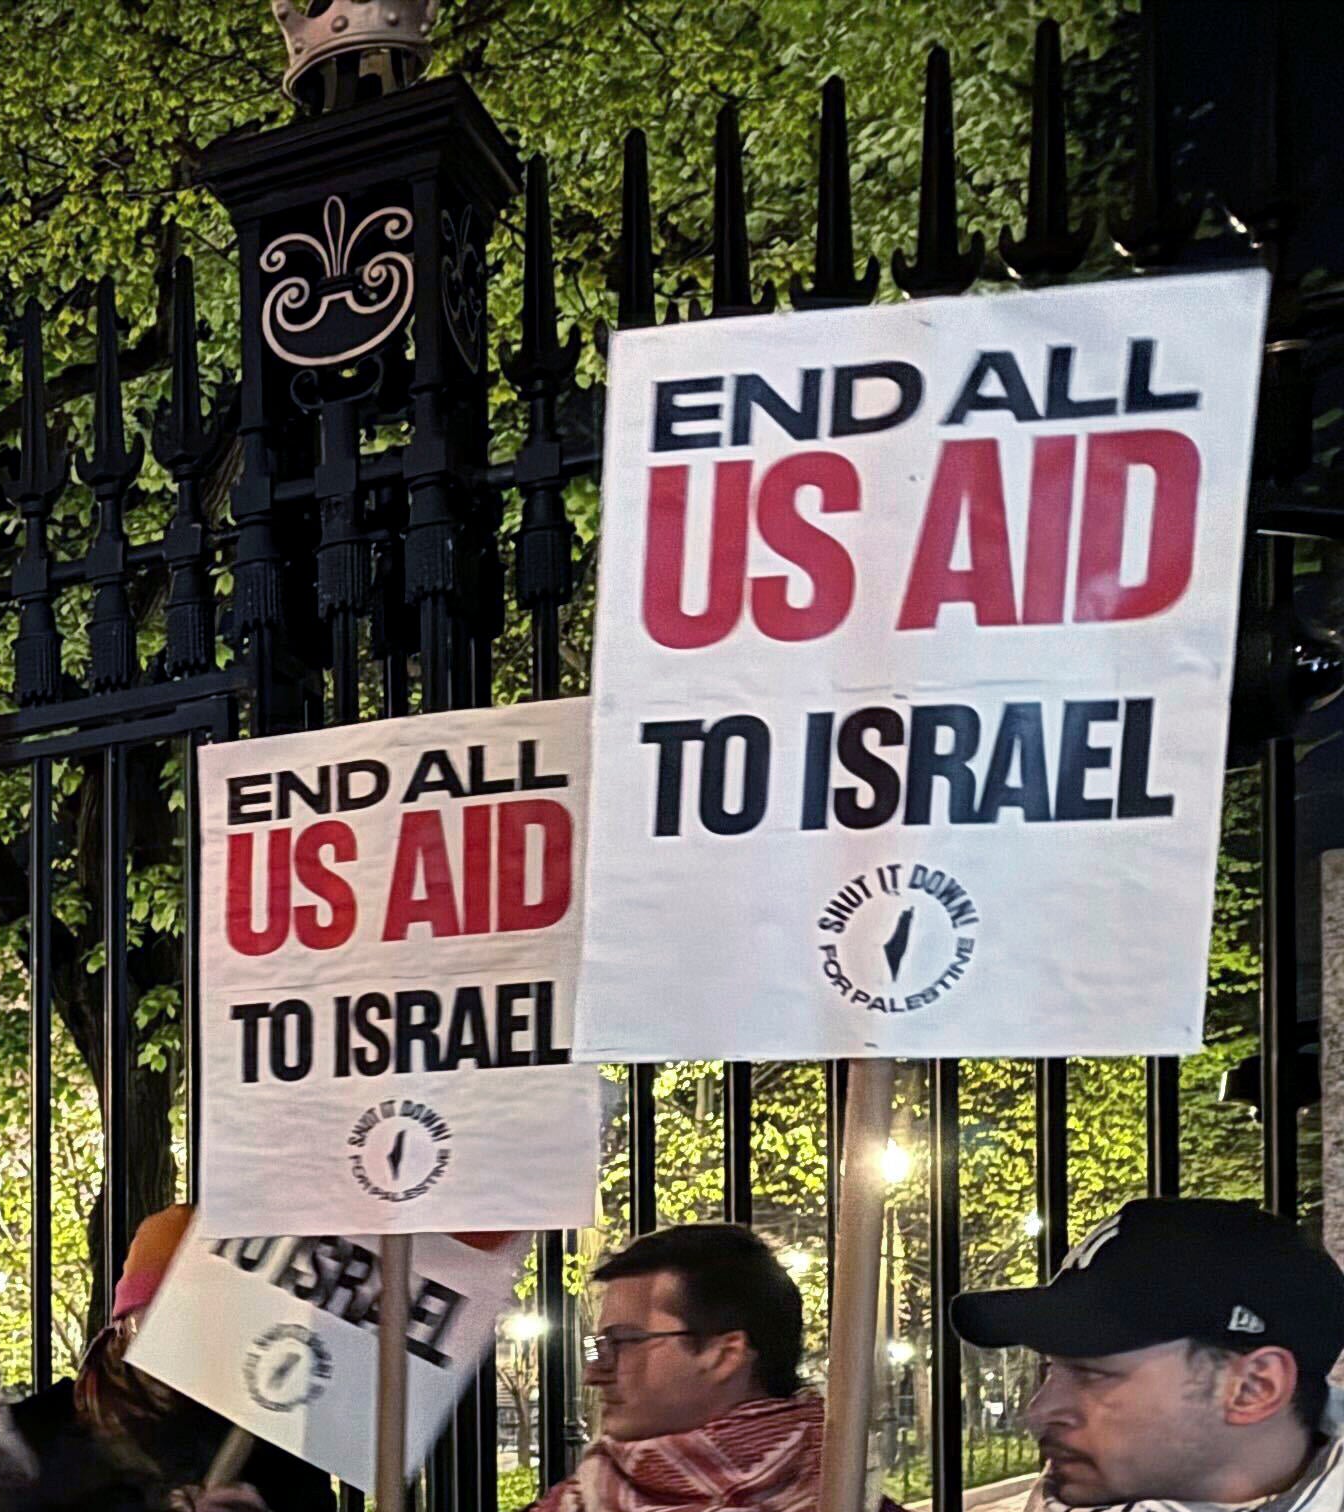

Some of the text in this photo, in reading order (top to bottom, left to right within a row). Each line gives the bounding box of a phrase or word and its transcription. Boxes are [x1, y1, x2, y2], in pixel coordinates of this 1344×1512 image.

[650, 338, 1201, 453] END ALL
[641, 428, 1202, 650] US AID
[226, 739, 569, 825] END ALL
[640, 697, 1175, 838] TO ISRAEL
[225, 798, 574, 957] US AID
[817, 875, 873, 934] SHUT
[908, 863, 980, 929] DOWN!
[818, 937, 976, 1014] FOR PALESTINE
[230, 980, 573, 1083] TO ISRAEL
